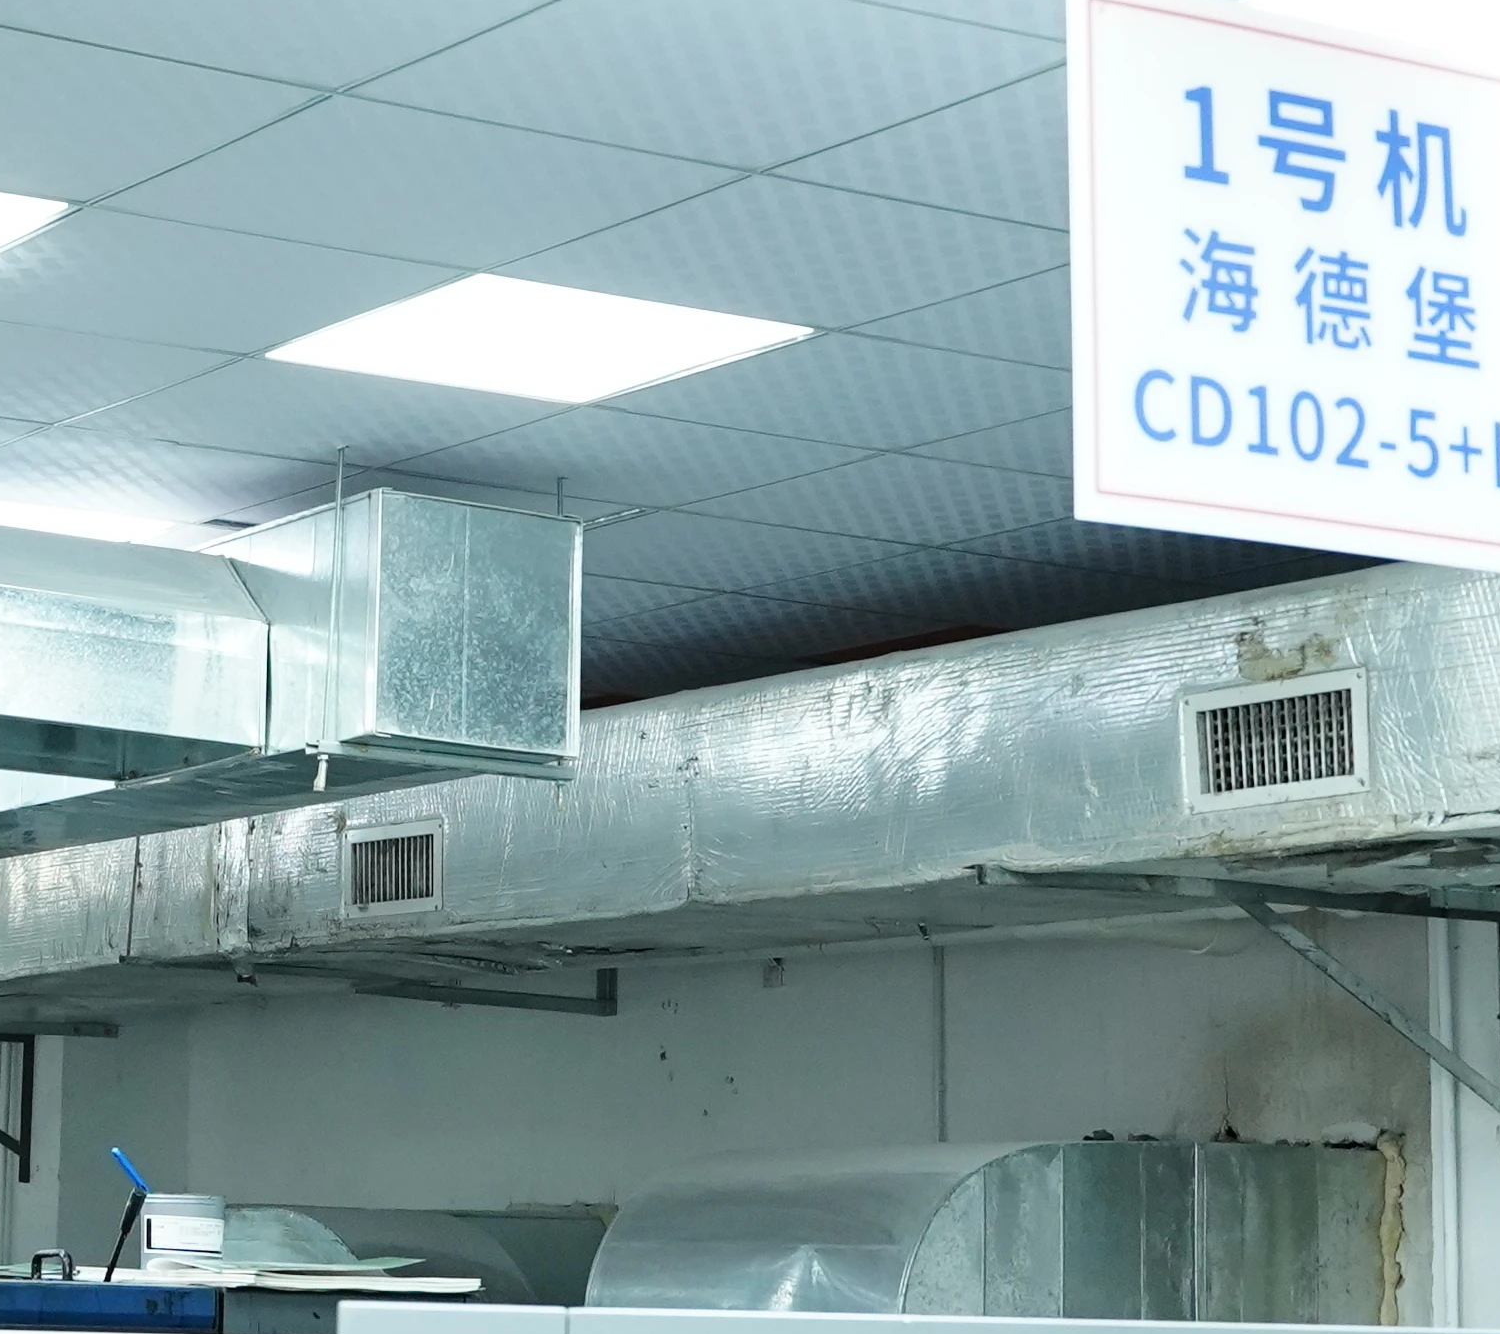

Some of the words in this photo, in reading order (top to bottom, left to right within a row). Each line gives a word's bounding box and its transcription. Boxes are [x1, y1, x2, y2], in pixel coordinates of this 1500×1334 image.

[1181, 84, 1468, 238] 1号机
[1178, 227, 1482, 370] 海德堡
